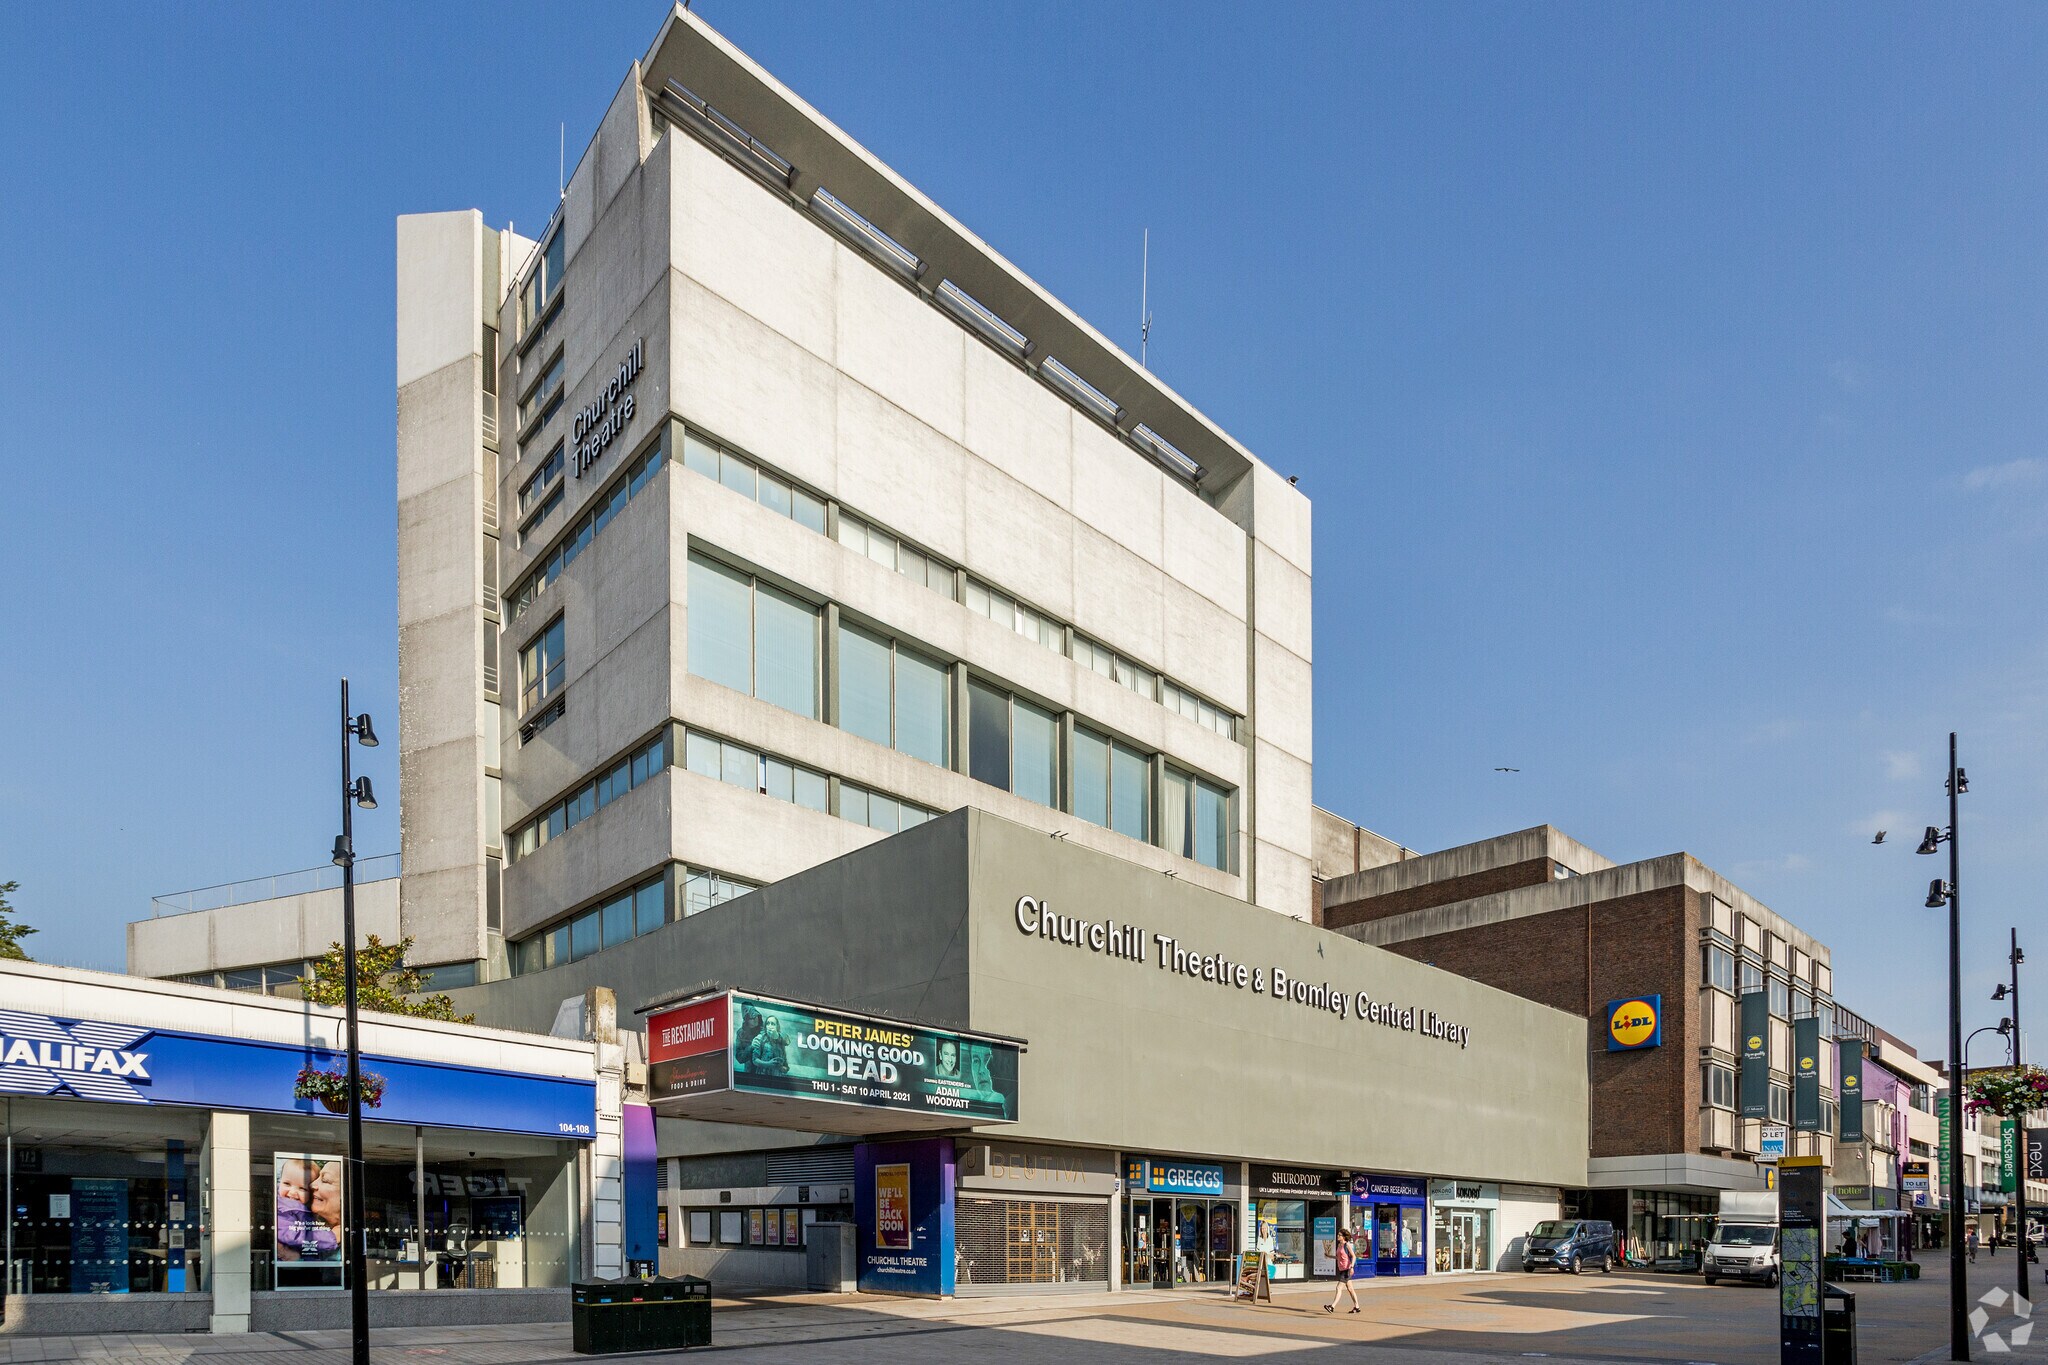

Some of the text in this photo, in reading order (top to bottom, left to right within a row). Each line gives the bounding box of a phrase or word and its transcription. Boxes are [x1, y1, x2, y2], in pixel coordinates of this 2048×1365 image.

[572, 337, 645, 445] Churchill
[572, 393, 636, 479] Theatre
[1015, 895, 1470, 1049] Churchill Theatre & Bromley Central Library
[662, 1018, 715, 1045] THE RESTAURANT
[814, 1019, 914, 1048] PETER JAMES'
[0, 1037, 151, 1078] ALIFAX
[797, 1032, 925, 1066] LOOKING GOOD
[827, 1053, 898, 1084] DEAD
[671, 1081, 684, 1090] FOOD
[691, 1078, 706, 1087] DRINK
[812, 1080, 829, 1091] THU
[831, 1083, 835, 1092] 1
[842, 1084, 857, 1095] SAT
[860, 1086, 868, 1096] 10
[869, 1087, 891, 1099] APRIL
[893, 1091, 911, 1101] 2021
[935, 1086, 960, 1098] ADAM
[938, 1079, 964, 1088] EASTENDERS
[926, 1095, 970, 1109] WOODYATT
[559, 1123, 590, 1134] 104-108
[1938, 1097, 1950, 1185] DEICHMANN
[2002, 1127, 2015, 1178] Specsavers
[2029, 1142, 2042, 1177] next
[1167, 1168, 1220, 1188] GREGGS
[1272, 1172, 1321, 1186] SHUROPODY
[879, 1187, 903, 1198] WE'LL
[1371, 1184, 1418, 1195] CANCER RESEARCH UK
[879, 1198, 890, 1208] BE
[880, 1209, 903, 1220] BACK
[880, 1220, 904, 1231] SOON
[867, 1256, 927, 1267] CHURCHILL THEATRE
